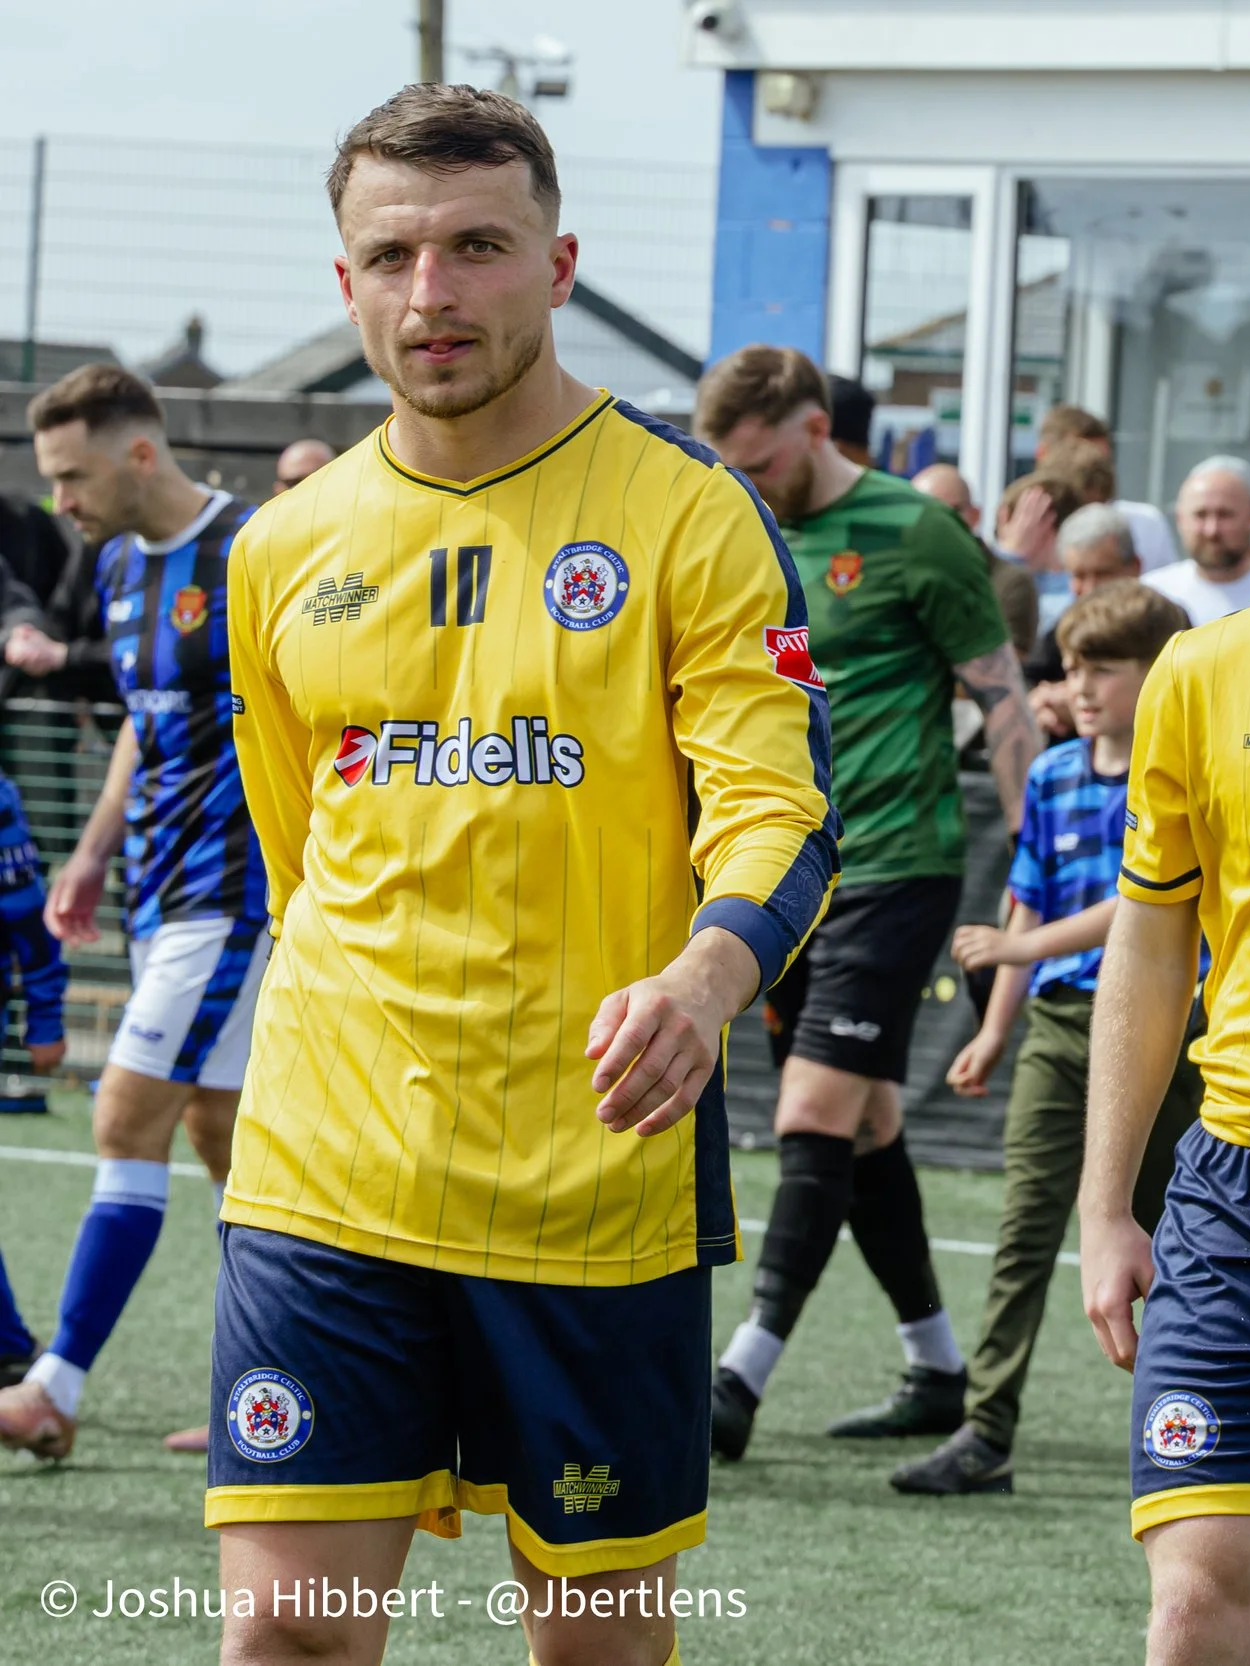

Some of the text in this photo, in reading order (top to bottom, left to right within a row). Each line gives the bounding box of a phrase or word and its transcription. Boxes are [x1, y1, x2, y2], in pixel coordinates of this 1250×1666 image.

[552, 544, 625, 573] STALYBRIDGE CELTIC
[430, 545, 493, 627] 10
[304, 587, 377, 610] MATCHWINNER
[550, 606, 614, 629] FOOTBALL CLUB
[374, 716, 584, 787] Fidelis
[233, 1373, 306, 1402] STALYBRIDGE CELTIC
[1190, 1397, 1213, 1419] CELTIC
[237, 1439, 300, 1459] FOOTBALL CLUB
[555, 1482, 618, 1495] MATCHWINNER
